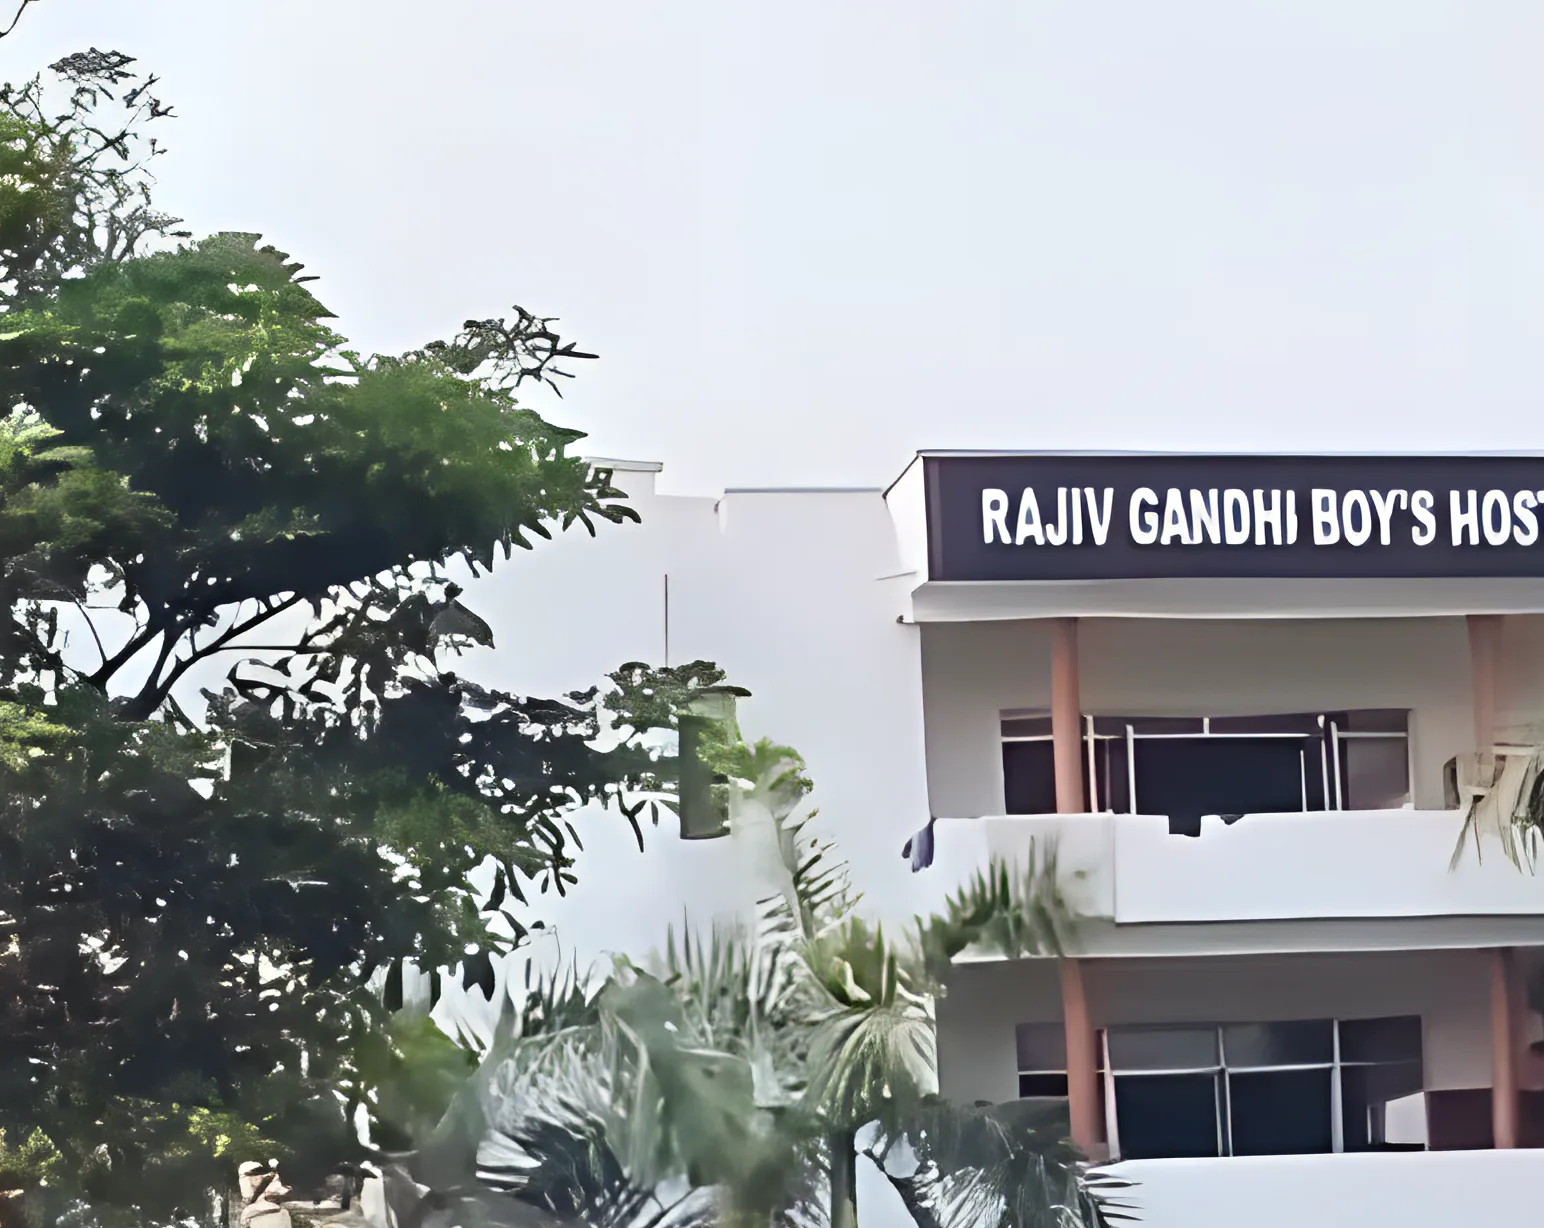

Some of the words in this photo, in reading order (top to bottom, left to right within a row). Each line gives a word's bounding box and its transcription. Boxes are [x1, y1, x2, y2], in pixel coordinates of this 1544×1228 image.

[981, 487, 1115, 546] RAJIV
[1129, 487, 1298, 546] GANDHI
[1311, 488, 1437, 547] BOY'S
